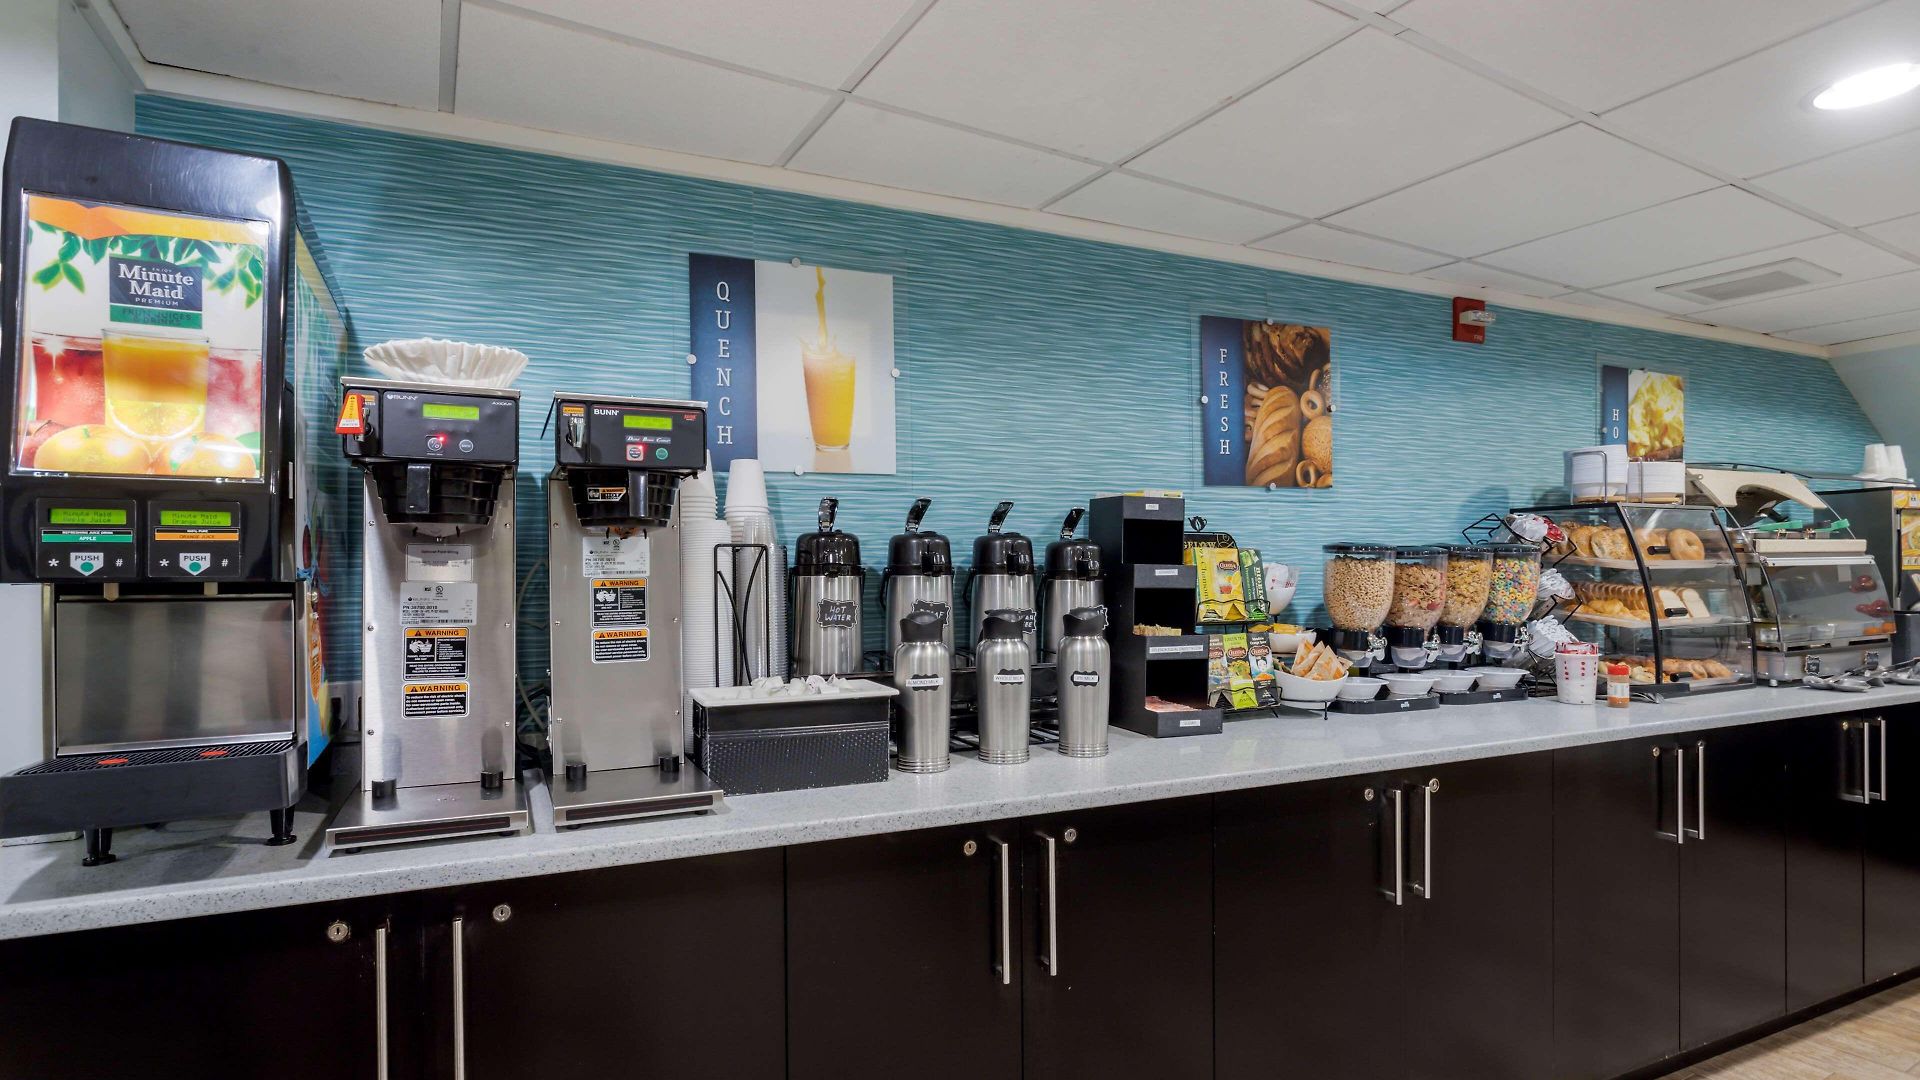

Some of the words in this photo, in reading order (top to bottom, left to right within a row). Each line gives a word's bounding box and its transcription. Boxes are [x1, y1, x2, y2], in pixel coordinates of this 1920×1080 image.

[118, 263, 194, 286] Minute
[129, 280, 184, 300] Maid
[135, 297, 179, 306] PREMIUM
[715, 281, 733, 445] QUENCH
[1219, 348, 1230, 455] FRESH
